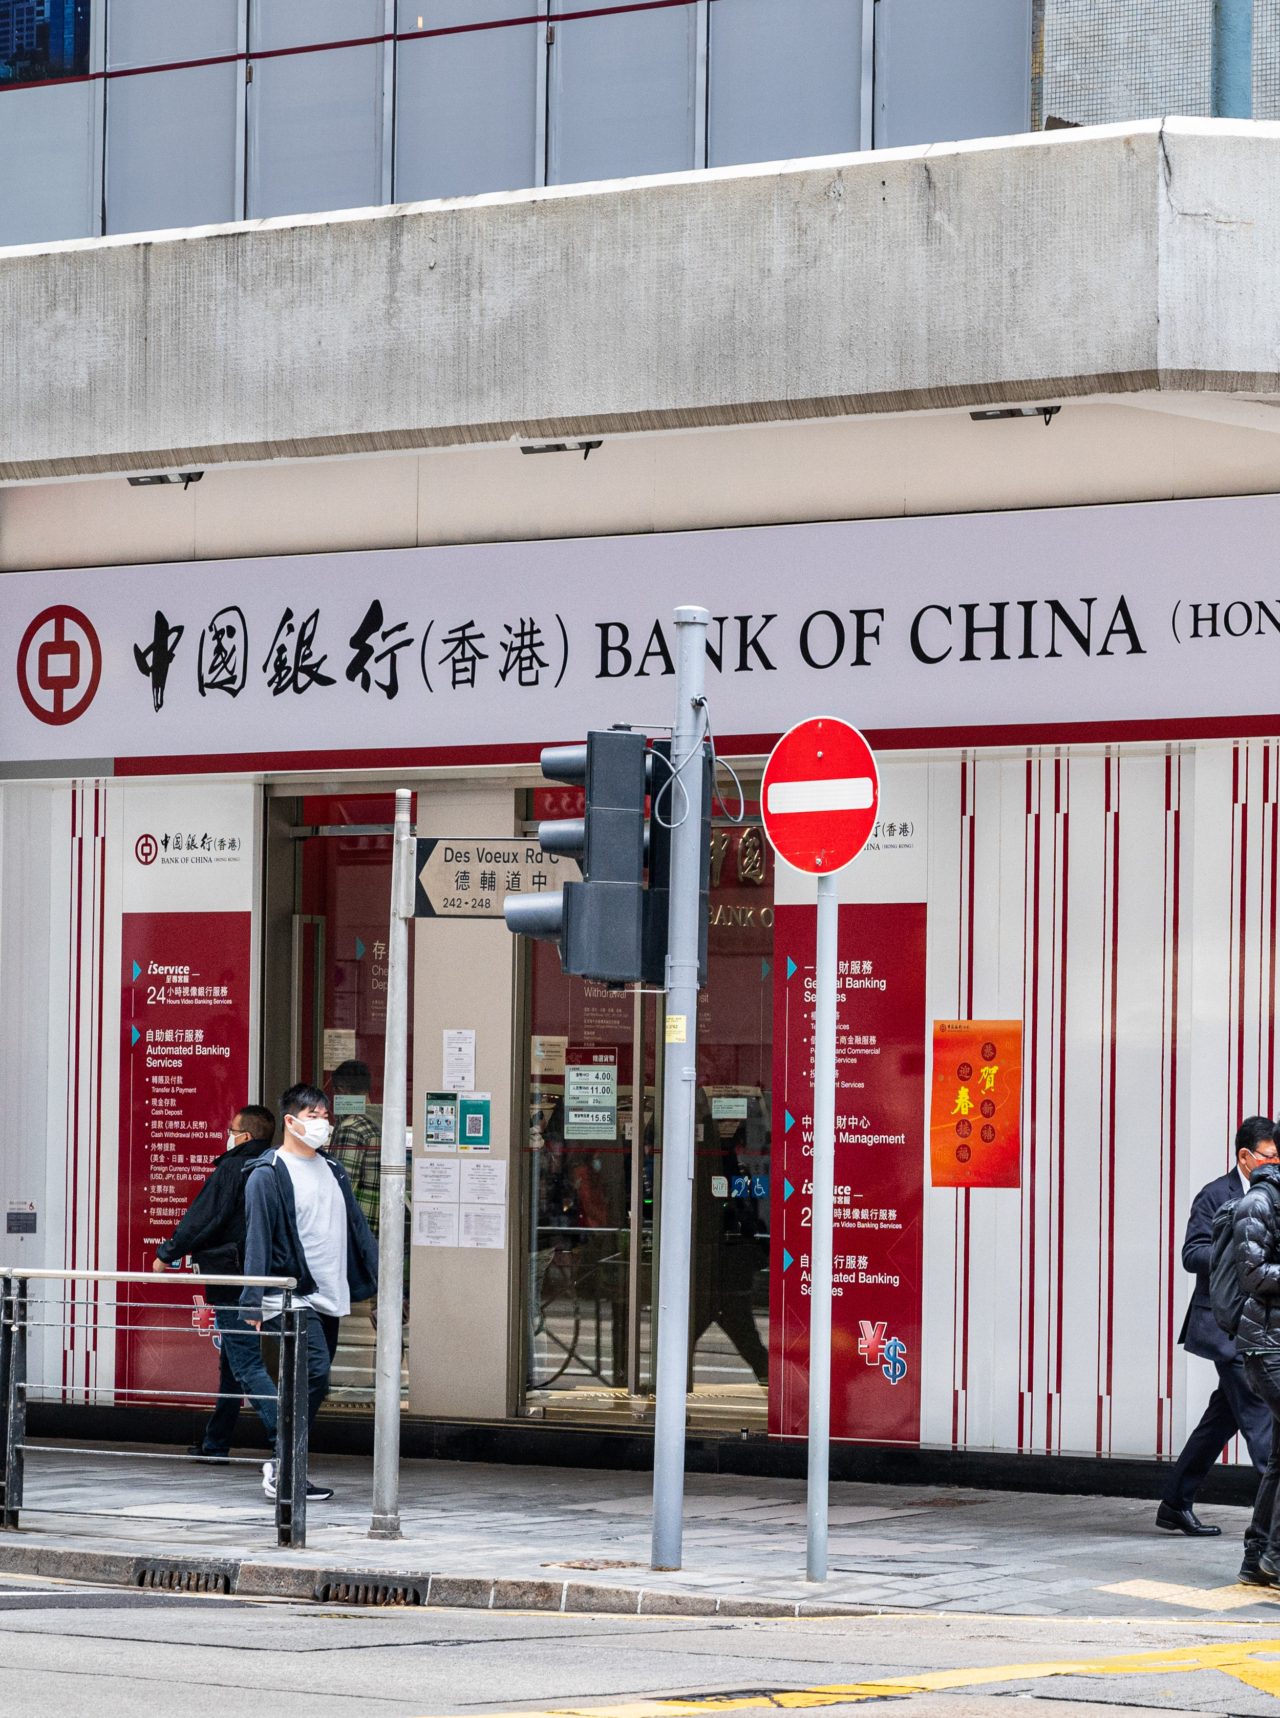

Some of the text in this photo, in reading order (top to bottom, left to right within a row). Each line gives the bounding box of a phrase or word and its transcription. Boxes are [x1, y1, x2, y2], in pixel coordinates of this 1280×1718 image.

[800, 607, 884, 670] OF
[910, 595, 1147, 665] CHINA
[190, 856, 213, 864] CHINA
[444, 847, 470, 863] Des
[476, 847, 519, 864] Voeux
[454, 870, 547, 893] 德輔道中
[147, 960, 190, 974] iService
[804, 960, 873, 975] 一財服務
[804, 977, 887, 991] Geal Banking
[146, 986, 166, 1005] 24
[804, 990, 847, 1002] Sees
[146, 1029, 204, 1043] 自助銀行服務
[146, 1045, 230, 1058] Automated Banking
[847, 1047, 881, 1055] Commercial
[146, 1057, 183, 1068] Services
[841, 1081, 865, 1089] Services
[165, 1109, 183, 1117] Deposit
[802, 1115, 871, 1130] 中財中心
[839, 1131, 906, 1146] Management
[801, 1179, 852, 1195] iSice
[833, 1208, 898, 1221] 時視像銀行服務
[857, 1221, 879, 1230] Banking
[800, 1254, 869, 1270] 自行服務
[800, 1271, 900, 1287] Auated Banking
[800, 1284, 844, 1297] Sees
